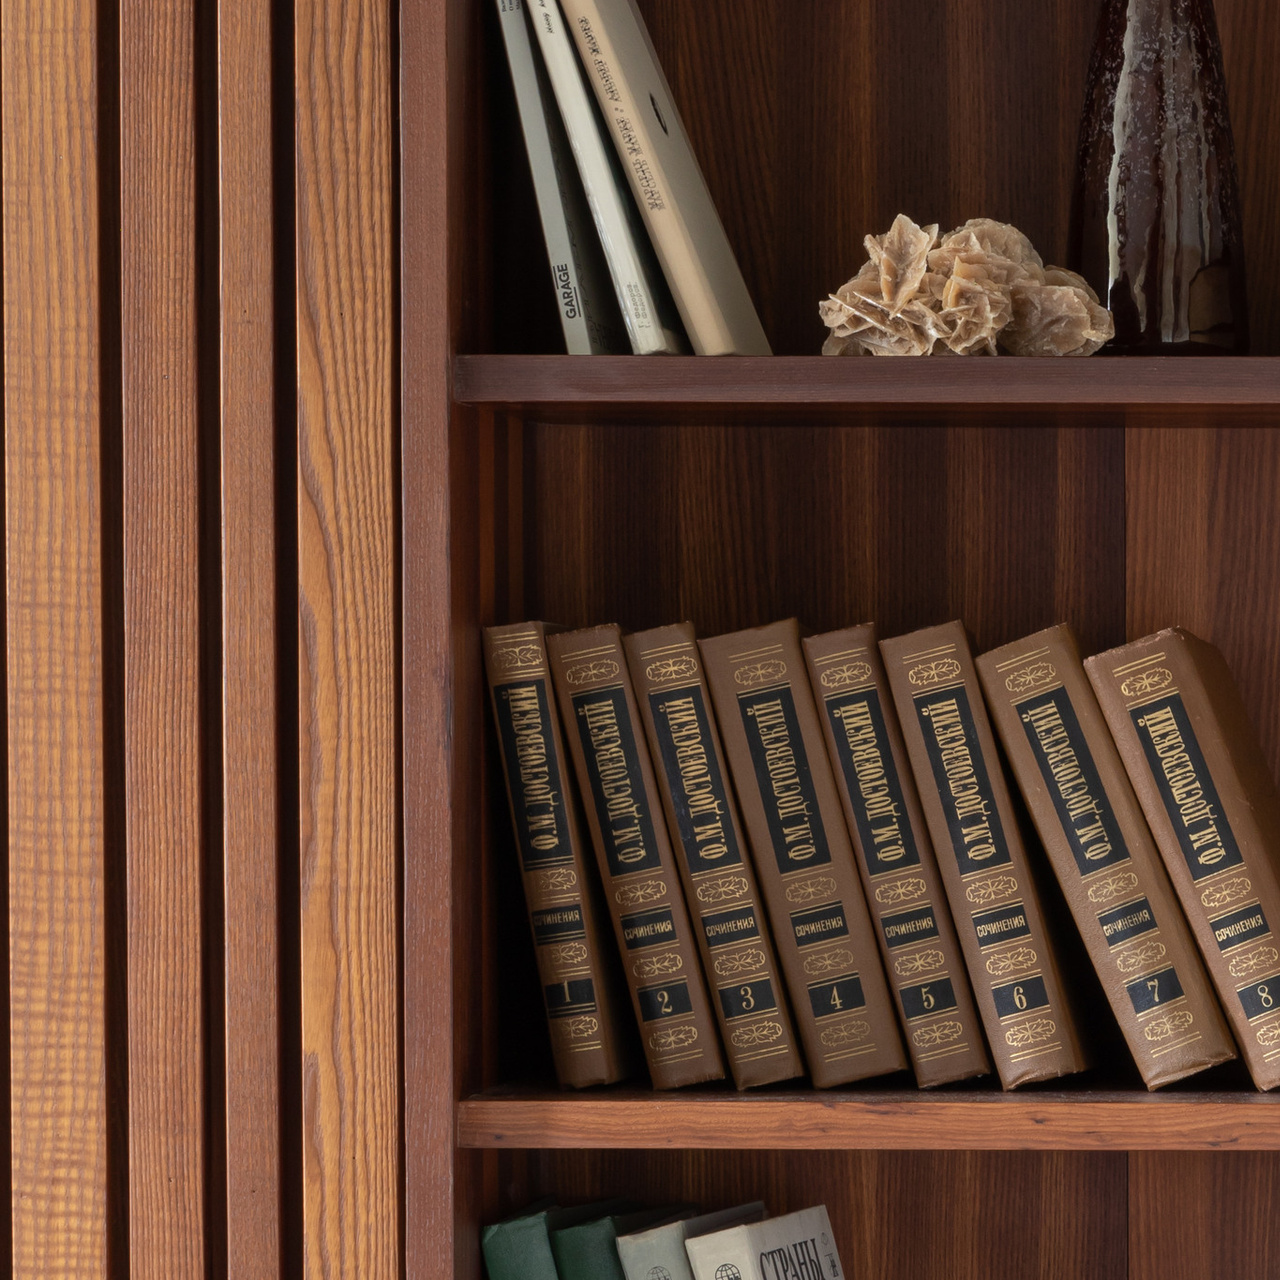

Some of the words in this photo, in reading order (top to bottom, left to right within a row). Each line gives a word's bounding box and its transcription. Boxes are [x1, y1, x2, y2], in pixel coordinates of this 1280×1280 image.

[557, 263, 577, 319] GARAGE
[624, 922, 674, 939] СОЧИНЕНИЯ
[705, 917, 756, 937] СОЧИНЕНИЯ
[795, 918, 844, 938] СОЧИНЕНИЯ
[884, 918, 934, 938] СОЧИНЕНИЯ
[976, 917, 1026, 937] СОЧИНЕНИЯ
[1103, 911, 1152, 936] СОЧИНЕНИЯ
[1215, 915, 1264, 941] СОЧИНЕНИЯ
[561, 980, 572, 1004] 1
[656, 990, 673, 1015] 2
[740, 986, 756, 1010] 3
[829, 986, 844, 1010] 4
[919, 987, 935, 1009] 5
[1012, 987, 1027, 1009] 6
[1147, 980, 1160, 1003] 7
[1257, 985, 1273, 1008] 8
